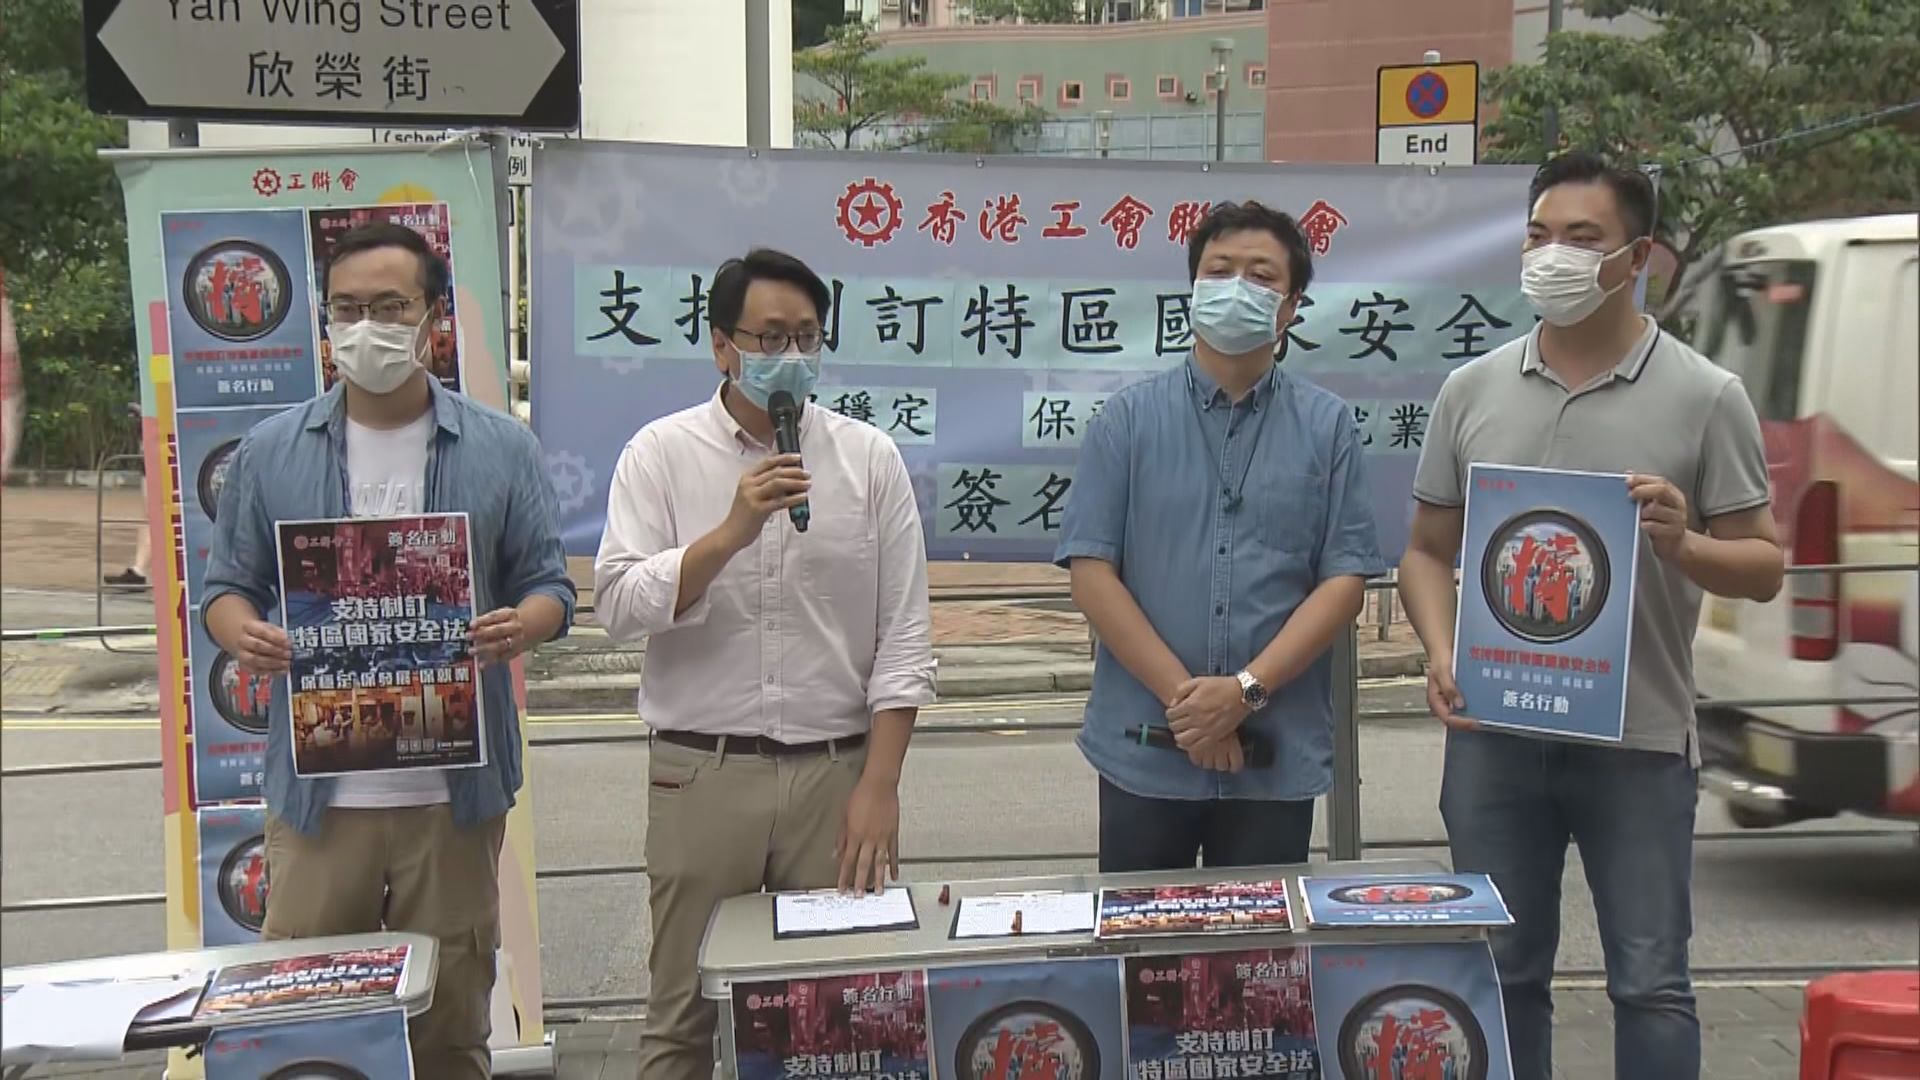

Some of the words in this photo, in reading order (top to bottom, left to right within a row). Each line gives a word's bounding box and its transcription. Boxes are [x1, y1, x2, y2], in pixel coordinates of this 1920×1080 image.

[168, 0, 241, 22] Yan
[263, 0, 362, 33] Wing
[380, 0, 511, 31] Street
[247, 51, 431, 101] 欣榮街
[1406, 132, 1448, 154] End
[287, 168, 359, 193] 工聯會
[917, 191, 1348, 256] 香港工會聯會
[586, 269, 1543, 362] 支訂特區國安全
[808, 389, 932, 437] 穩定
[944, 467, 1073, 533] 簽名
[330, 594, 428, 621] 支持制訂
[293, 617, 468, 649] 特區國家安全法
[1503, 690, 1570, 714] 簽名行動
[1175, 1028, 1274, 1055] 支持制訂
[783, 1050, 882, 1079] 支持制訂
